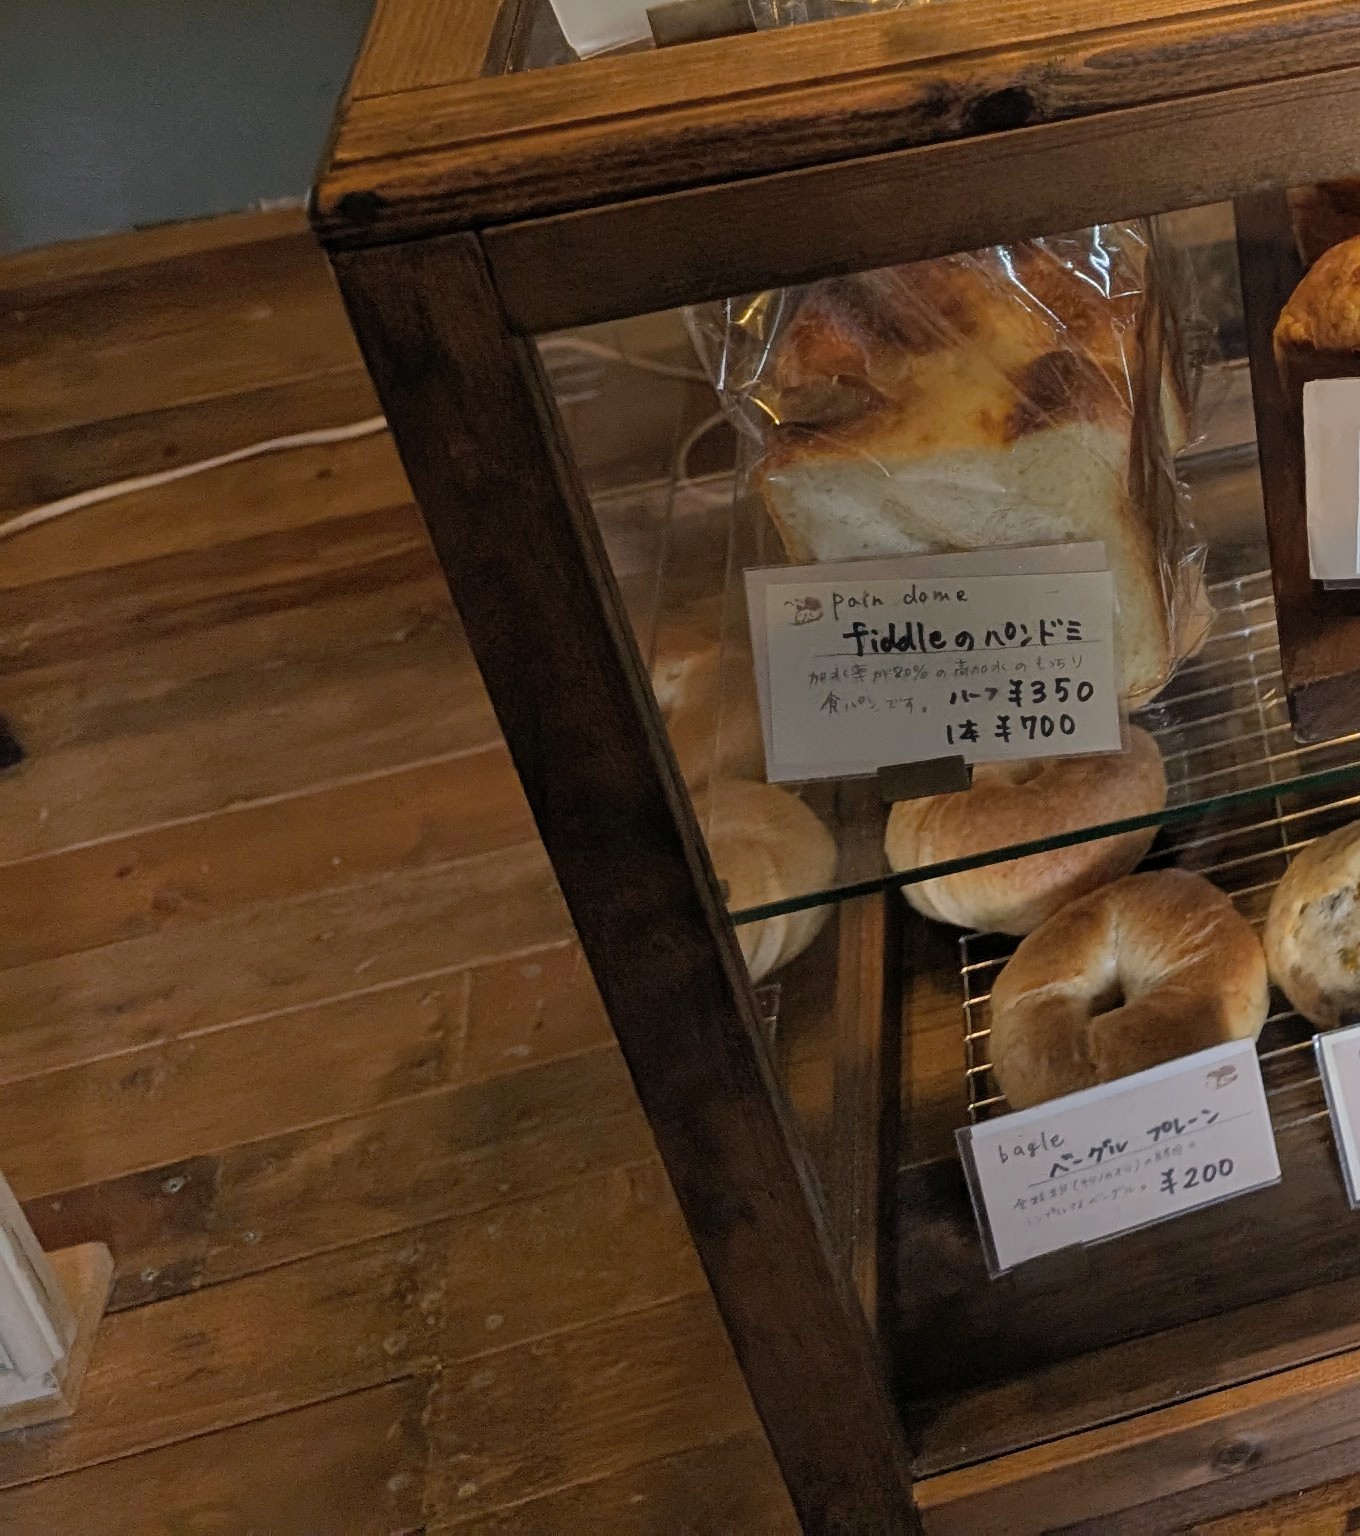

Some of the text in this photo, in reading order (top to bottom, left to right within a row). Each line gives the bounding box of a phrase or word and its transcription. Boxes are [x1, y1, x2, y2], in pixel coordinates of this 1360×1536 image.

[902, 584, 968, 606] dome
[949, 678, 1095, 707] ハーフ ¥350
[946, 713, 1076, 745] 1本 ¥700
[1049, 1137, 1129, 1179] ベーグル
[1159, 1157, 1234, 1195] ¥200
